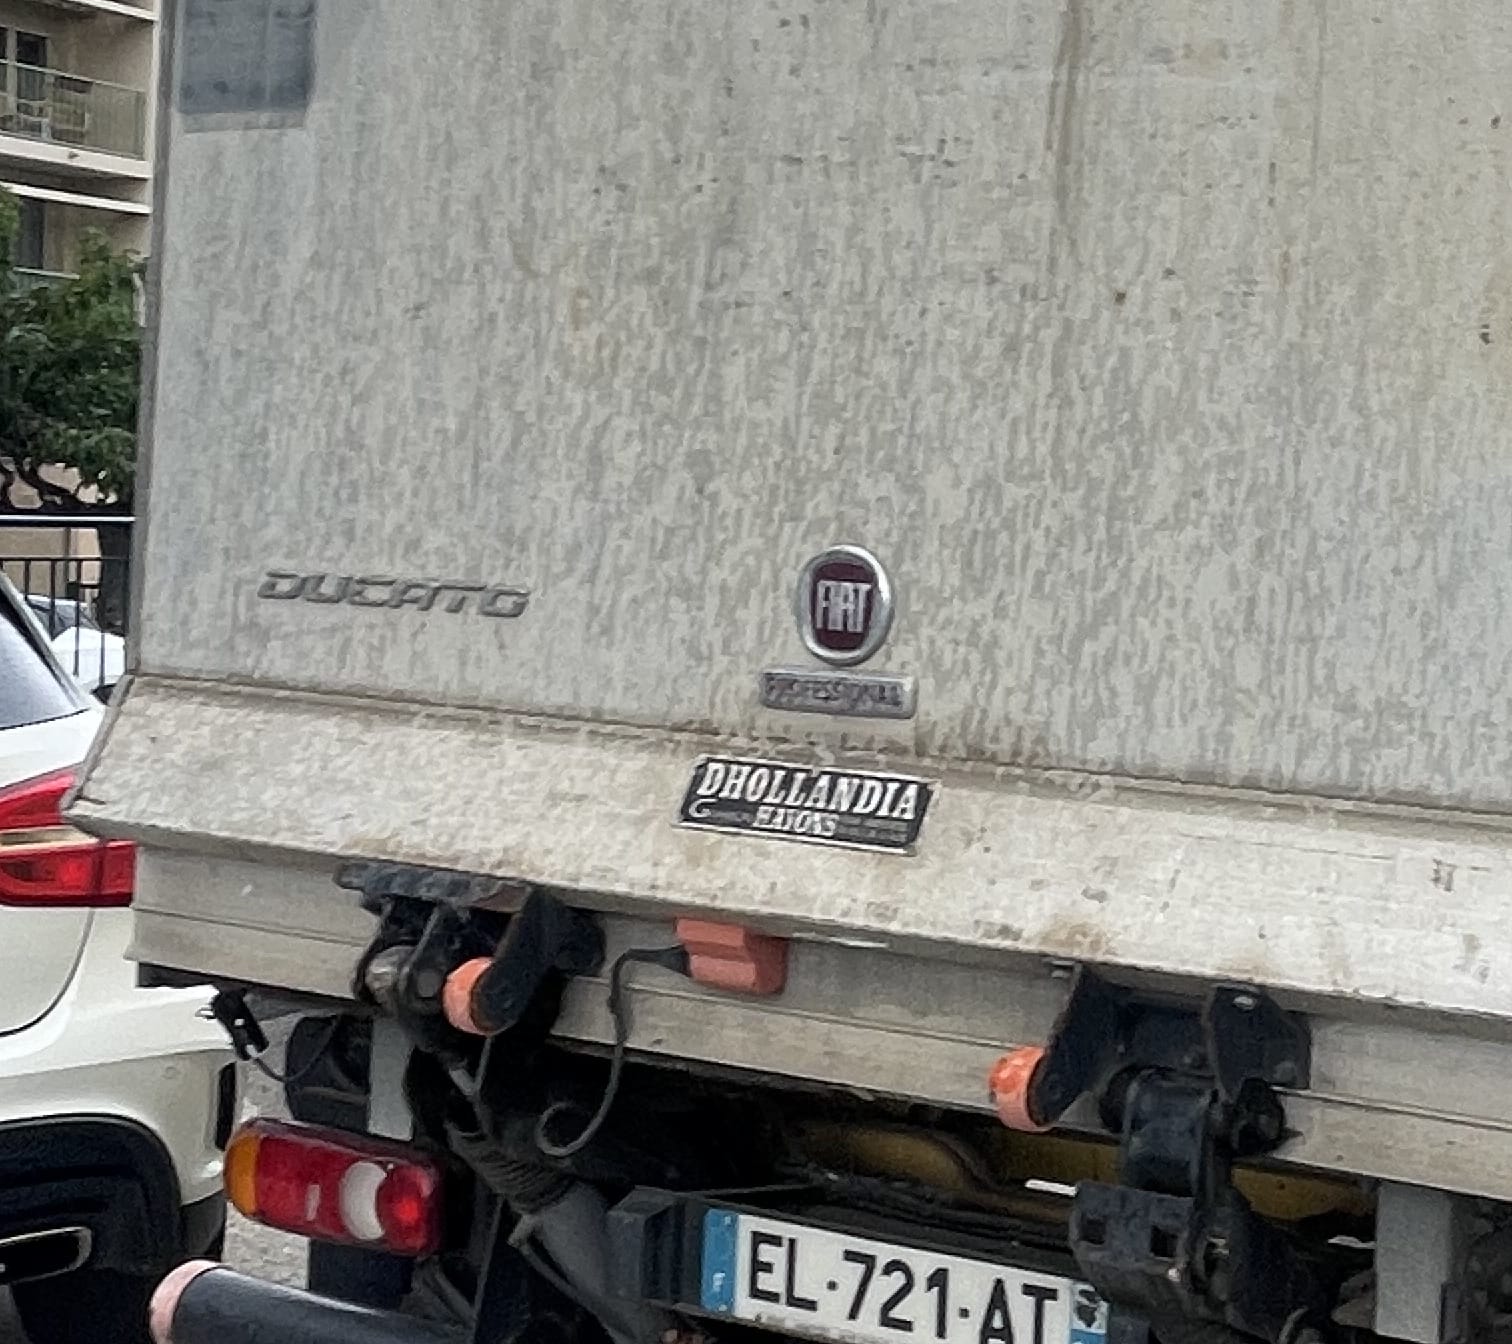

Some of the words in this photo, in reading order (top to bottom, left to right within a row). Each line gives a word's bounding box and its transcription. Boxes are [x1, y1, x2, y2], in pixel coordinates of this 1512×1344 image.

[257, 571, 531, 618] DUCATO
[816, 579, 873, 633] FIAT
[696, 761, 919, 820] DHOLLANDIA
